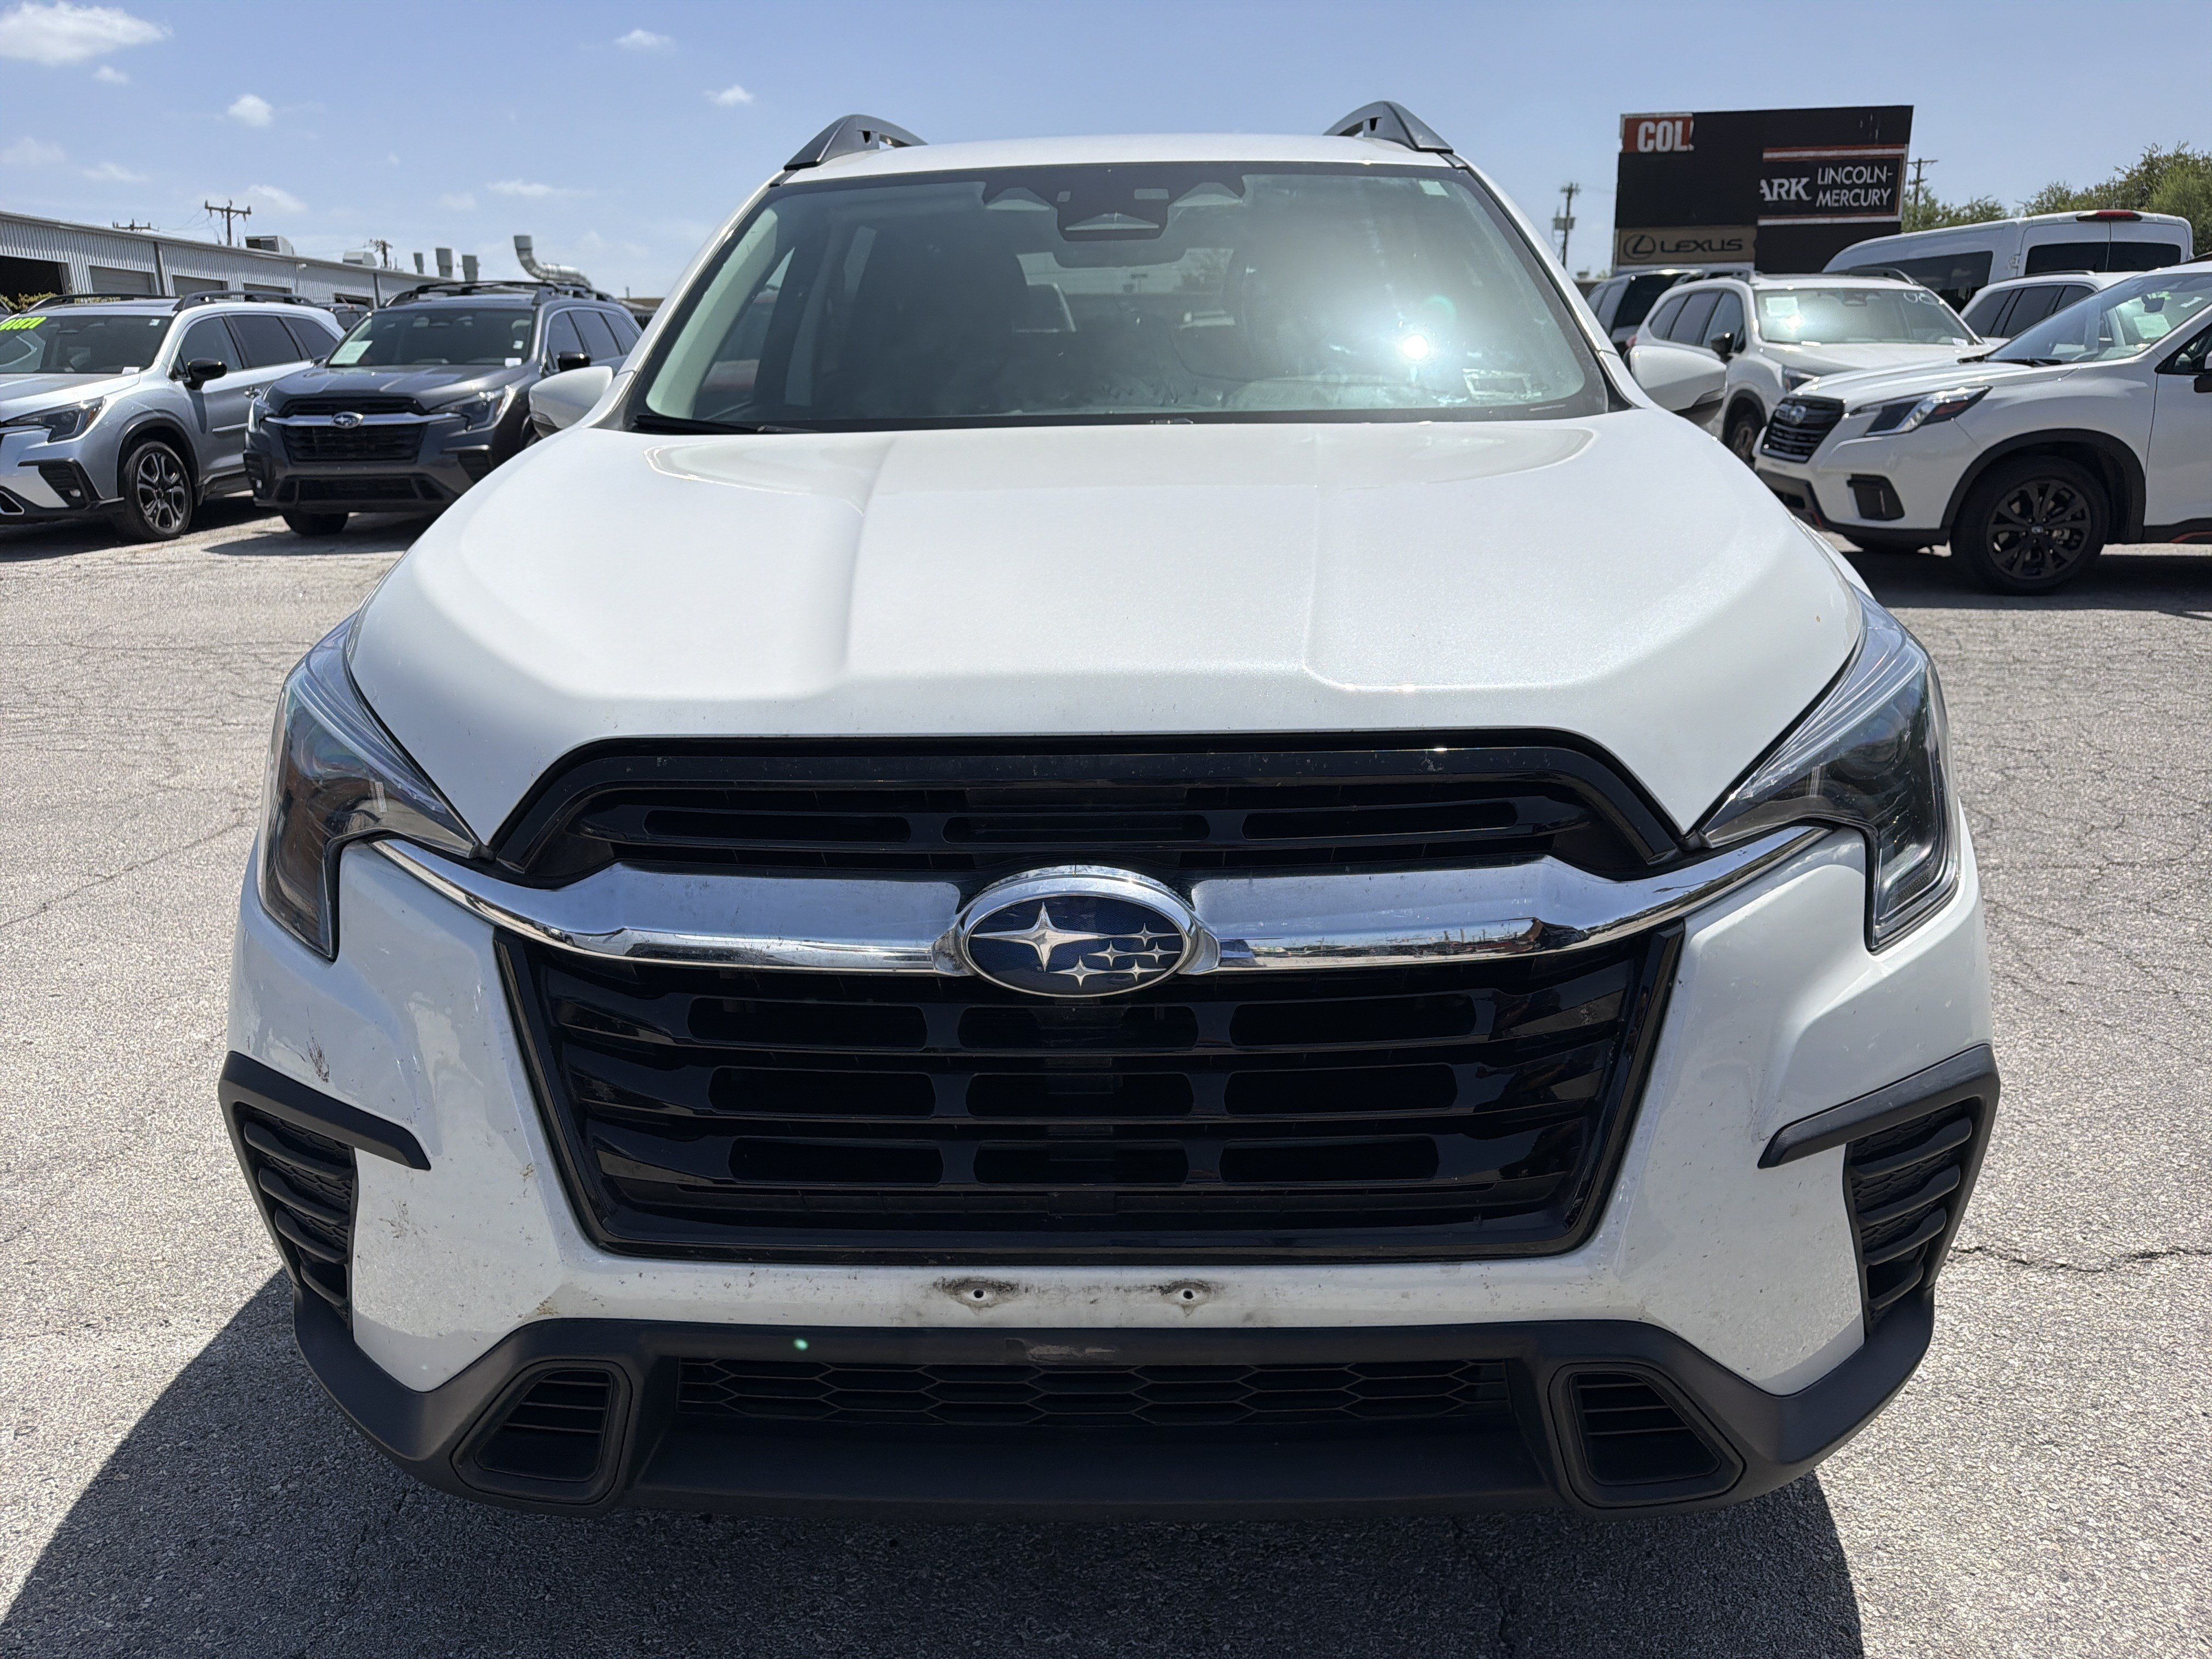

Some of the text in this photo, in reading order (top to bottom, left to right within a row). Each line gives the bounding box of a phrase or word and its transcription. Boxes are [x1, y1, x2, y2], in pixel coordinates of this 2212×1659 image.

[1637, 120, 1694, 153] COL
[1817, 166, 1893, 185] LINCOLN-
[1815, 188, 1891, 207] MERCURY
[1661, 238, 1743, 253] LEXUS
